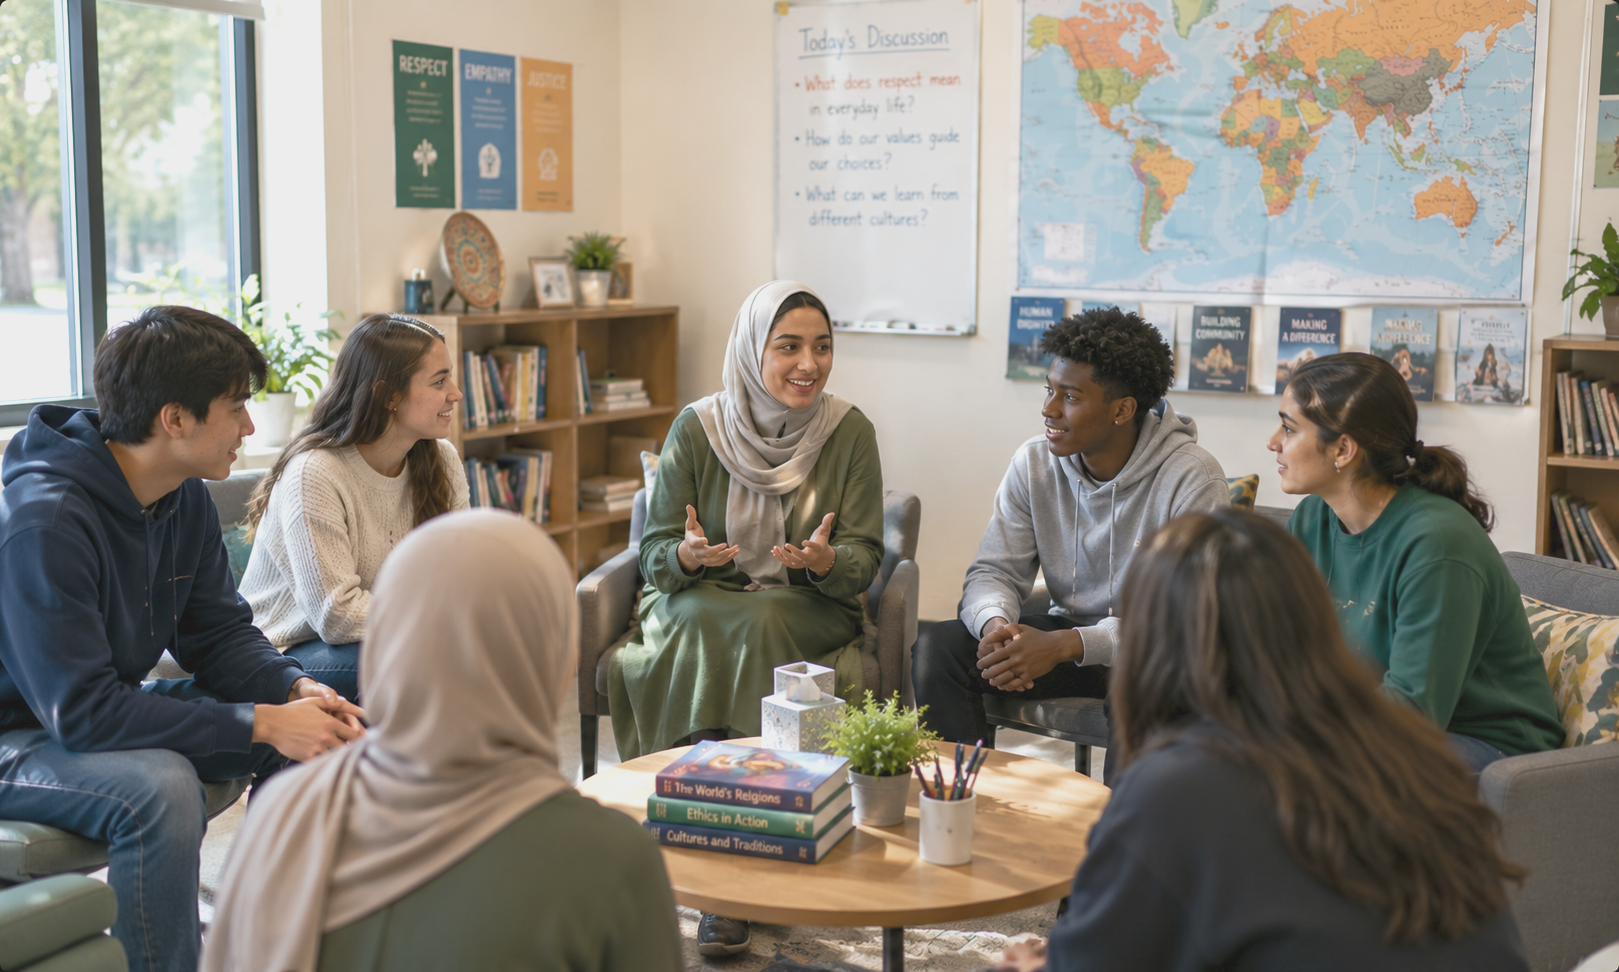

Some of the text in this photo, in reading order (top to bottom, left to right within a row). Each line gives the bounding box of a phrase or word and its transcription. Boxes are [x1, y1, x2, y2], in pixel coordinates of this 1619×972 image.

[798, 24, 949, 60] Today's Discussion
[399, 54, 448, 77] RESPECT
[464, 62, 513, 84] EMPATHY
[804, 71, 961, 92] What does respect mean
[809, 95, 915, 121] in everyday life?
[805, 127, 960, 151] How do our values guide
[809, 152, 893, 171] our choices?
[805, 183, 959, 201] What can we learn from
[809, 208, 929, 227] different cultures?
[1200, 315, 1242, 328] BUILDING
[1291, 318, 1328, 330] MAKING
[1195, 328, 1246, 340] COMMUNITY
[1282, 331, 1289, 342] A
[675, 781, 693, 794] The
[695, 784, 732, 799] World's
[687, 807, 769, 829] Ethics in Action
[667, 830, 784, 855] Cultures and Traditions
